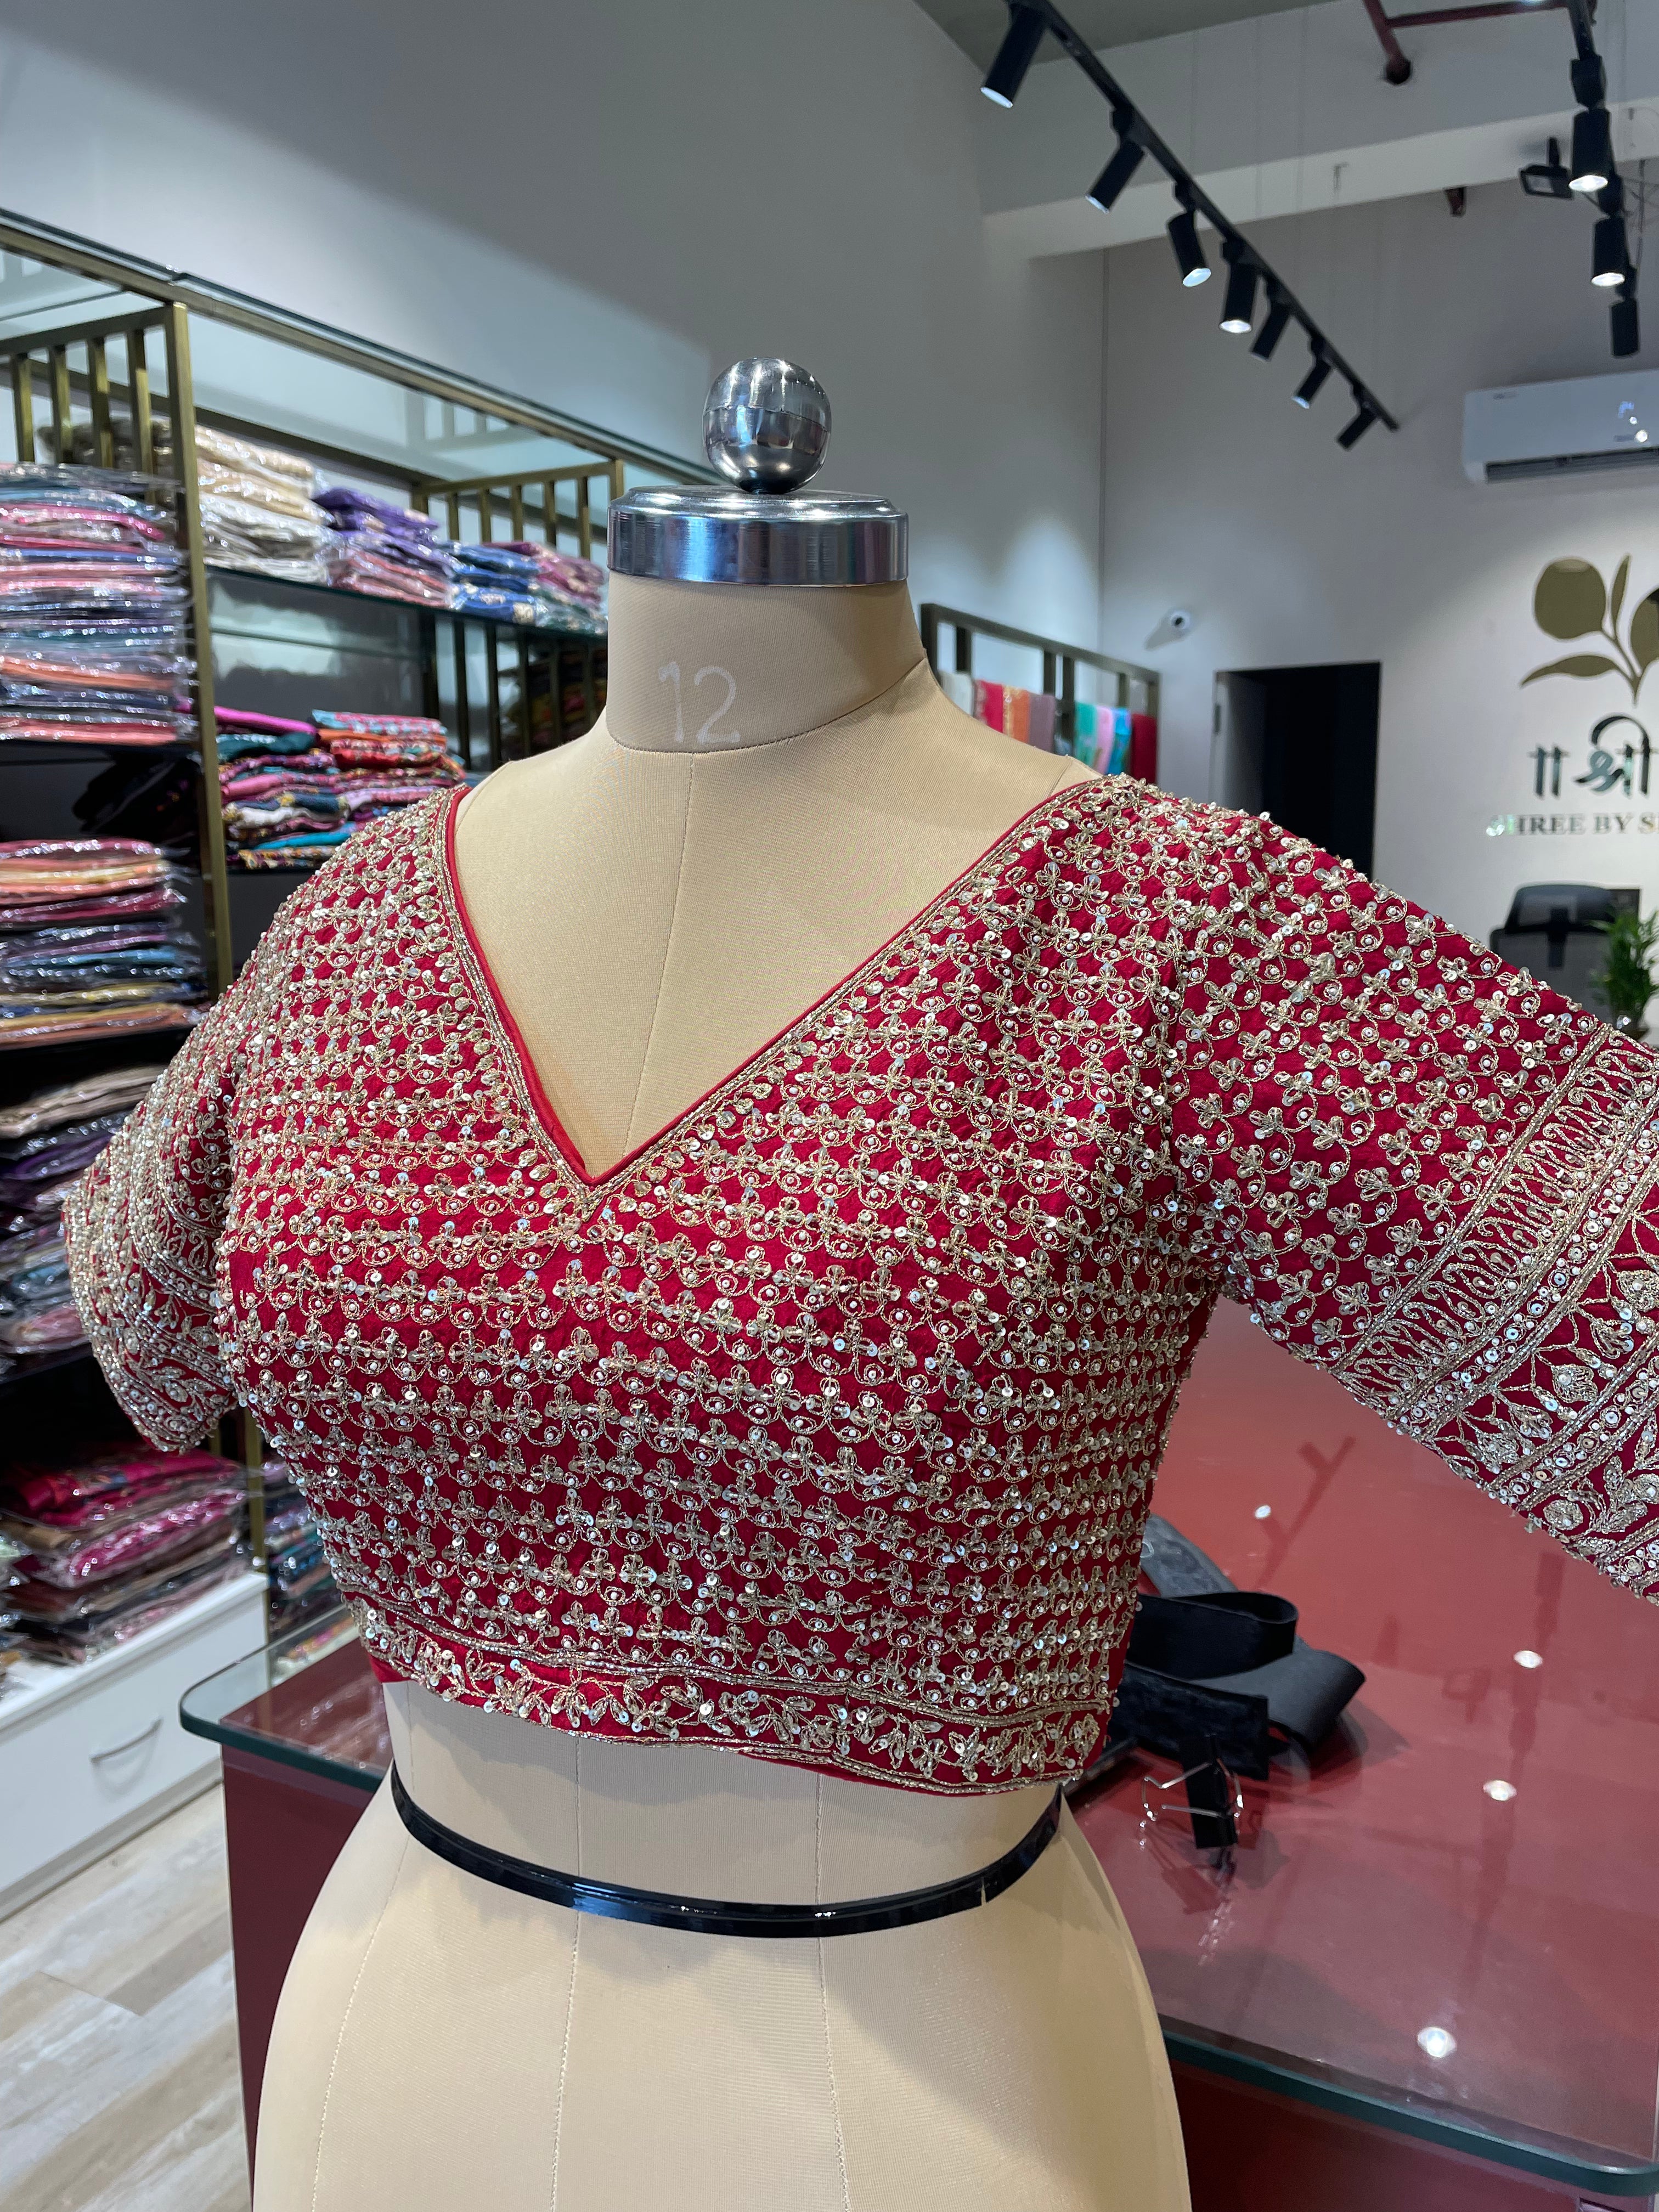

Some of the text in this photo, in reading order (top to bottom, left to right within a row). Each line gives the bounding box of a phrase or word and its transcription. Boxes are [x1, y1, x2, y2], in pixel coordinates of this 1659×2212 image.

[658, 661, 740, 744] 12
[1593, 813, 1634, 834] BY
[1638, 812, 1659, 835] S
